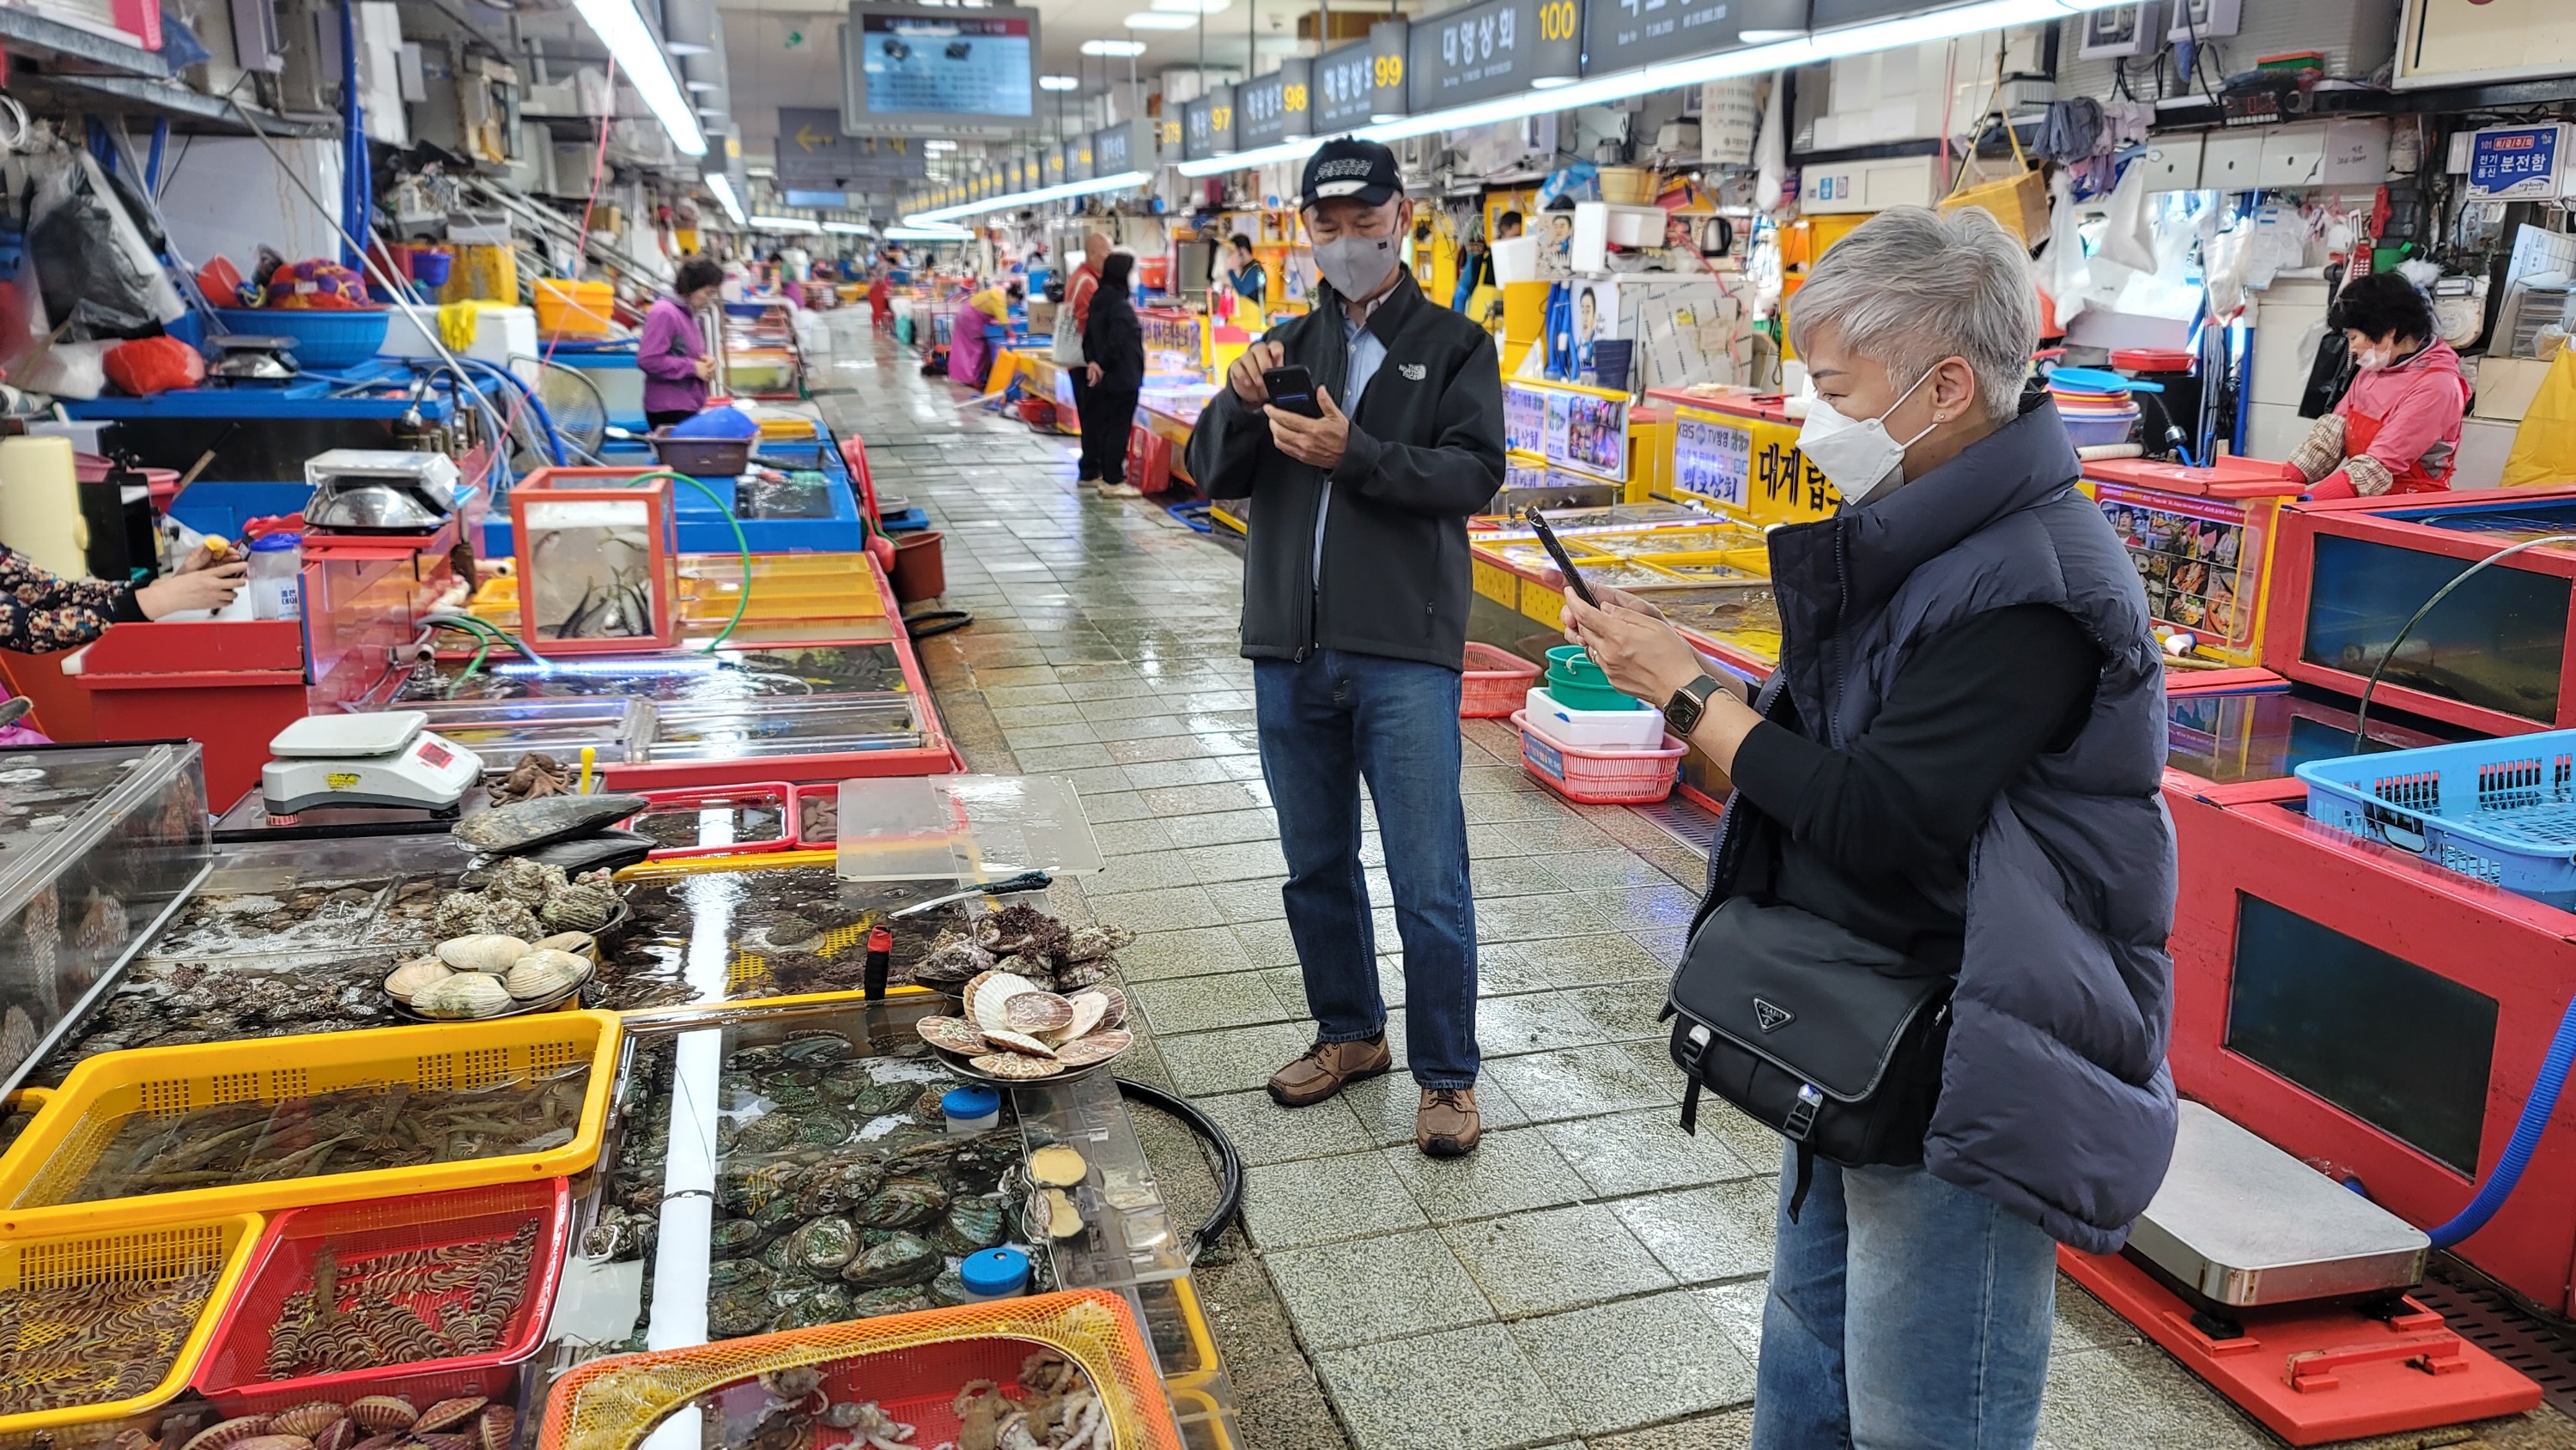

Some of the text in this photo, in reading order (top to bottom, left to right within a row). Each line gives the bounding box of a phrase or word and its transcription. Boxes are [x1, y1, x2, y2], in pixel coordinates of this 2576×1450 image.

[1540, 1, 1576, 40] 100
[1375, 54, 1403, 88] 99
[1284, 83, 1308, 112] 98
[1212, 106, 1232, 131] 97
[2481, 140, 2493, 149] 101
[2477, 167, 2496, 179] 통신
[2479, 153, 2547, 173] 전기 분전함
[1677, 423, 1695, 440] KBS
[1708, 428, 1729, 448] TV방영
[1683, 466, 1738, 504] 백호상회
[1759, 442, 1801, 507] 대게
[1759, 1004, 1783, 1020] PRADA
